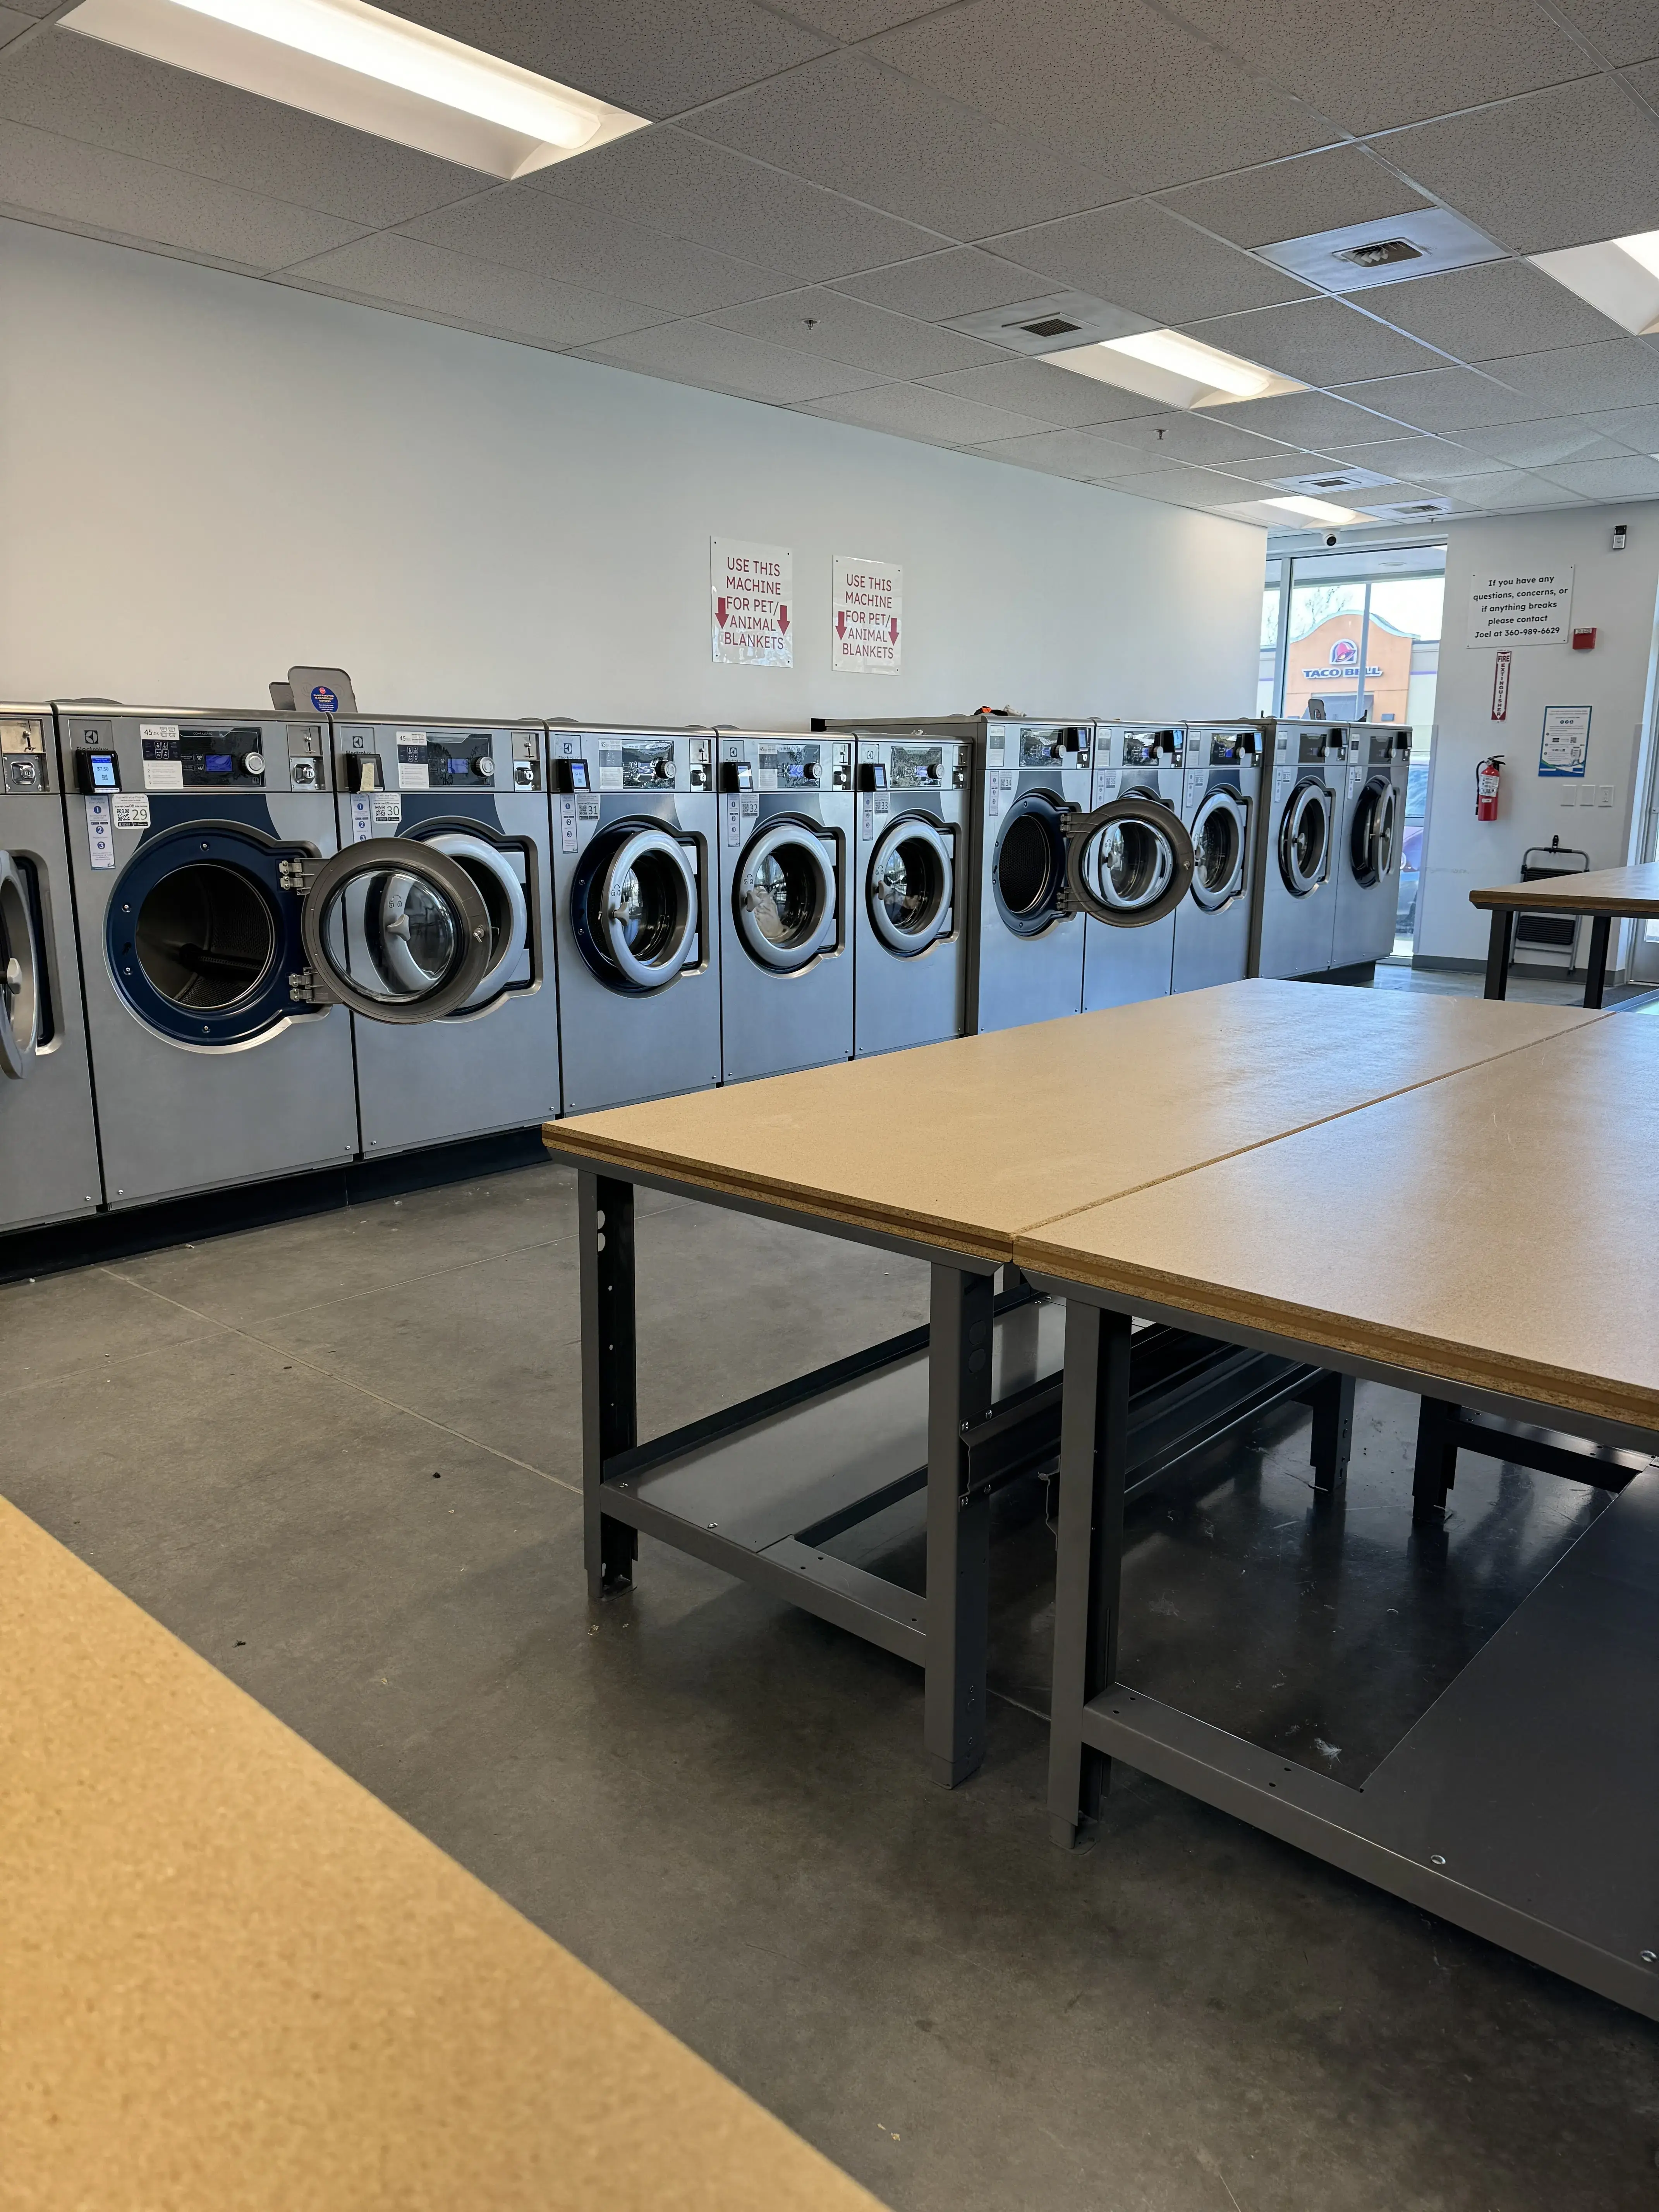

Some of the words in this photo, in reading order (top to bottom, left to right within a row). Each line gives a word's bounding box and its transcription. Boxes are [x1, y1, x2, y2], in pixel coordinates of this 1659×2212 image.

[727, 557, 749, 572] USE
[753, 561, 780, 576] THIS
[726, 575, 781, 595] MACHINE
[847, 574, 865, 588] USE
[868, 577, 891, 591] THIS
[846, 591, 892, 608] MACHINE
[1473, 592, 1514, 601] questions,
[727, 596, 749, 611] FOR
[754, 599, 779, 616] PET/
[1489, 603, 1526, 613] anything
[730, 615, 776, 631] ANIMAL
[846, 610, 865, 623] FOR
[869, 613, 890, 628] PET/
[1488, 618, 1514, 626] please
[848, 627, 888, 642] ANIMAL
[1504, 627, 1560, 637] 360-989-6629
[725, 632, 783, 650] BLANKETS
[843, 643, 893, 659] BLANKETS
[1304, 669, 1339, 677] TACO
[1497, 663, 1505, 716] EXTINGUISHER
[132, 809, 147, 820] 29
[387, 806, 399, 816] 30
[588, 806, 598, 815] 31
[750, 804, 757, 812] 32
